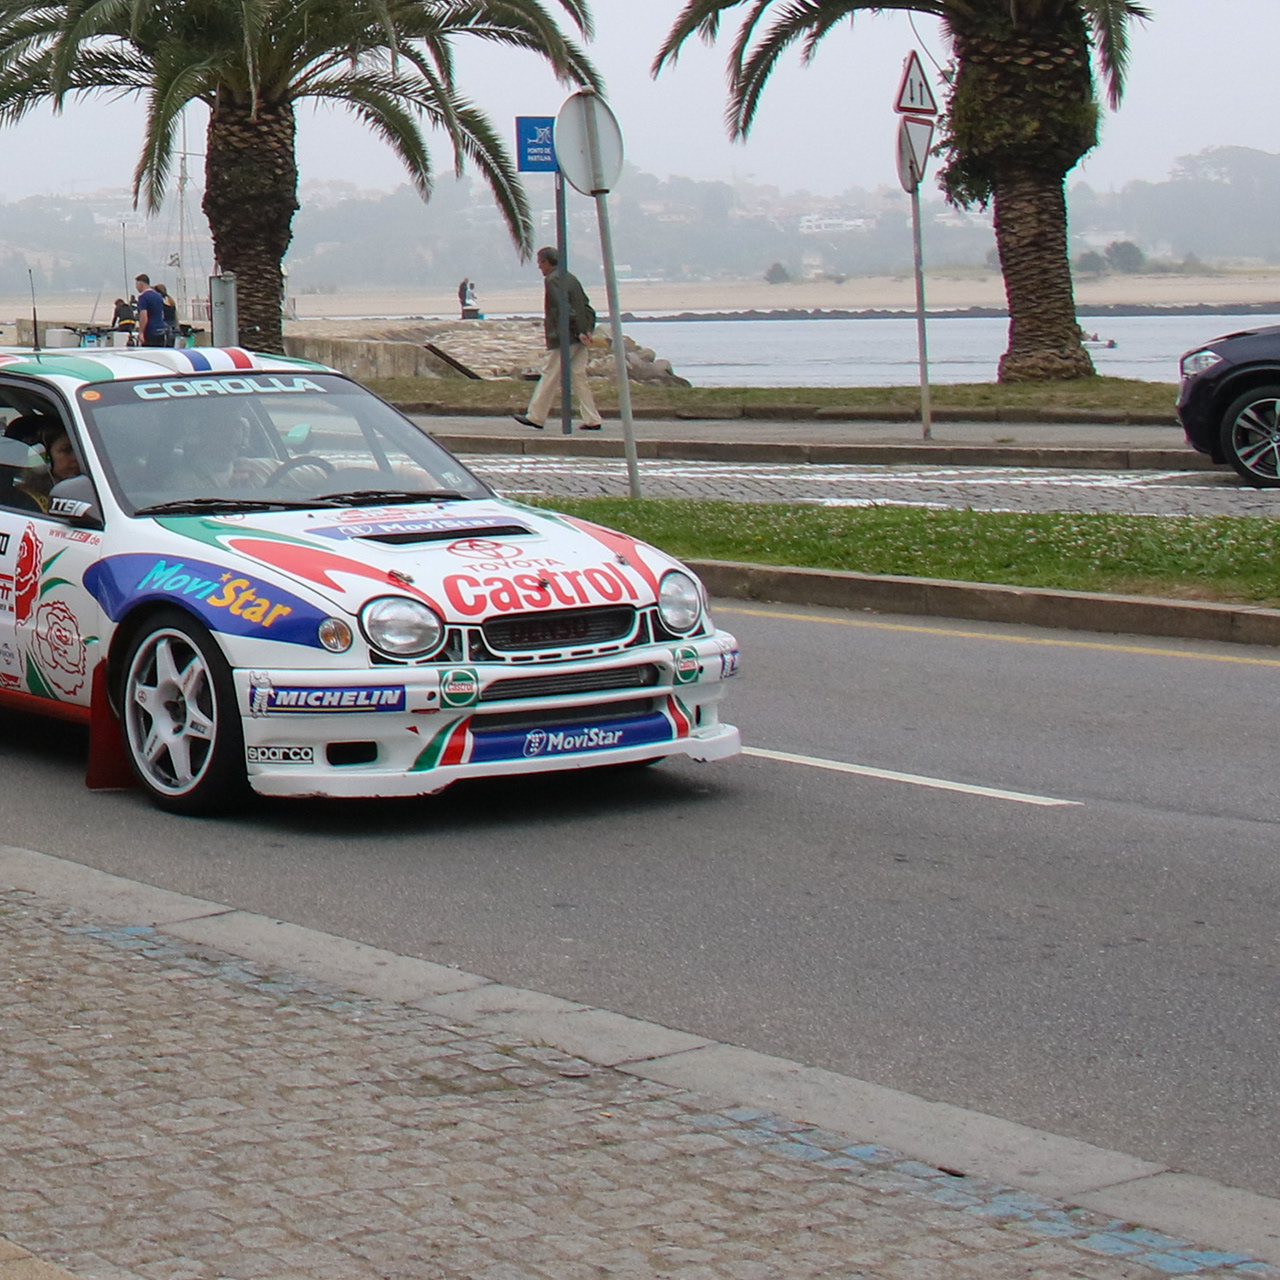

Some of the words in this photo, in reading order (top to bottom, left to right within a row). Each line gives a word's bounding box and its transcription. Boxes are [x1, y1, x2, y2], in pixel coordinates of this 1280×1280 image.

[133, 378, 328, 400] COROLLA
[462, 558, 566, 572] TOYOTA
[137, 560, 292, 627] MoviStar
[443, 562, 640, 616] Castrol
[275, 690, 401, 706] MICHELIN
[546, 728, 623, 752] MoviStar
[247, 747, 313, 761] sparco
